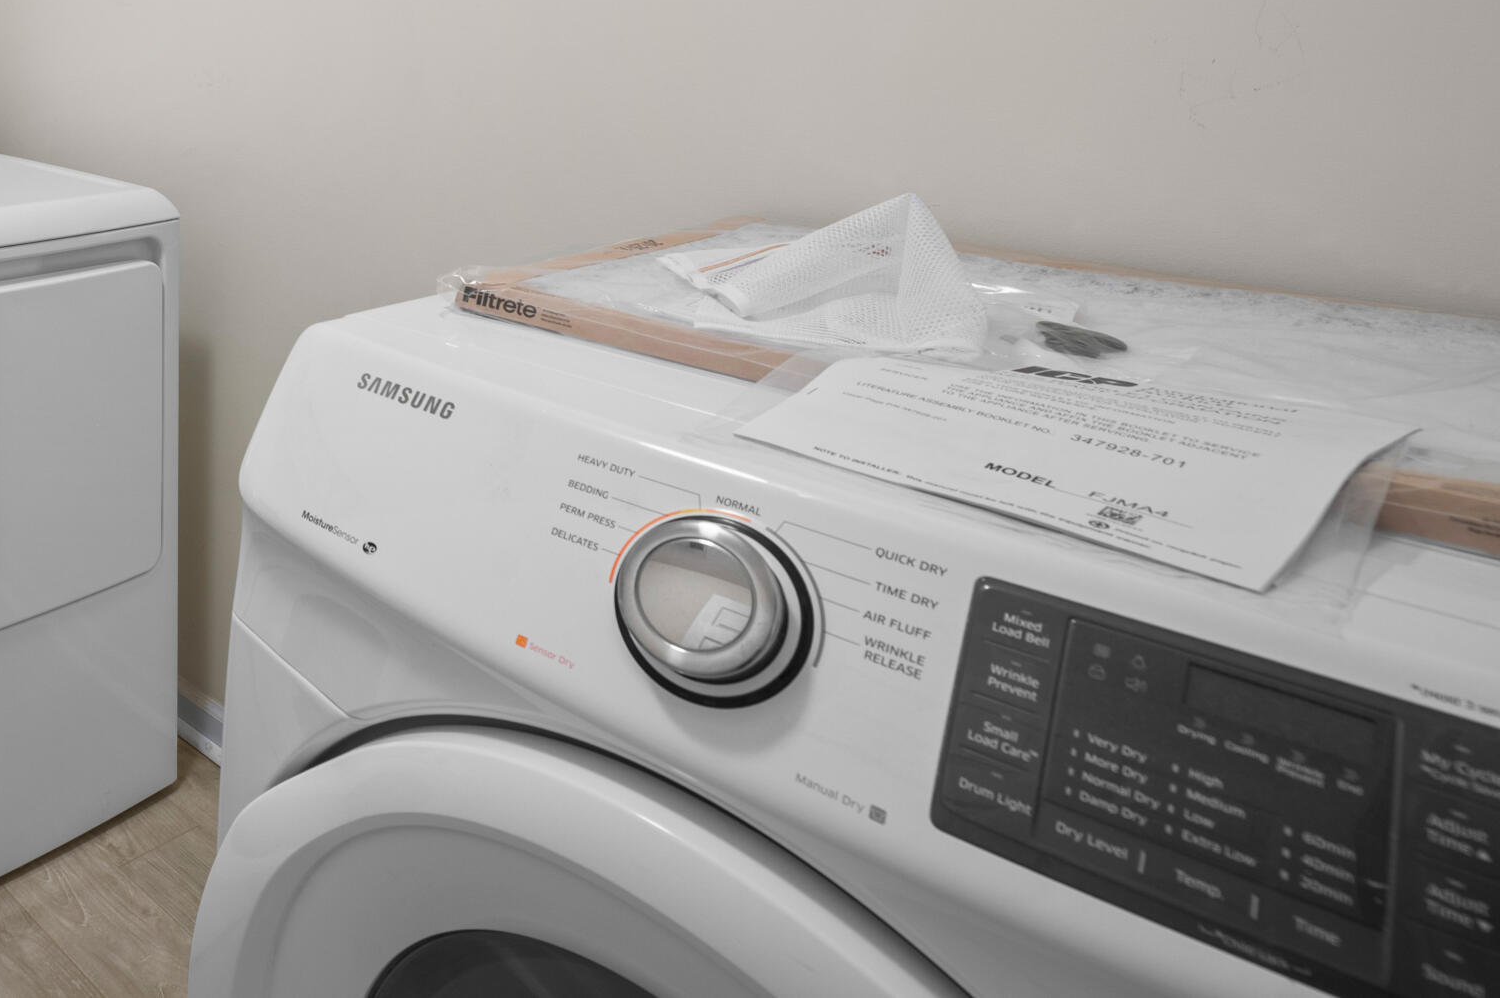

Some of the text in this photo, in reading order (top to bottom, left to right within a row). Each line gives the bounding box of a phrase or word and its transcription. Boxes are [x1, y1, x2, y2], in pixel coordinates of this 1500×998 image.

[462, 285, 537, 319] Filtrete
[1012, 365, 1138, 388] ICP
[357, 373, 455, 420] SAMSUNG
[918, 394, 973, 415] ASSEMBLY
[976, 409, 1028, 430] BOOKLET
[1070, 434, 1187, 469] 347928-701
[577, 453, 636, 478] HEAVY DUTY
[567, 479, 610, 500] BEDDING
[984, 461, 1056, 489] MODEL
[1088, 491, 1169, 518] FJMA4
[559, 502, 616, 529] PERM PRESS
[715, 495, 762, 517] NORMAL
[551, 526, 600, 552] DELICATES
[875, 547, 948, 577] QUICK DRY
[876, 581, 939, 610] TIME DRY
[863, 610, 932, 640] AIR FLUFF
[991, 622, 1050, 649] Load Bell
[1004, 612, 1043, 633] Mixed
[864, 635, 926, 667] WRINKLE
[864, 650, 923, 681] RELEASE
[987, 676, 1038, 702] Prevent
[990, 663, 1040, 690] Wrinkle
[967, 729, 999, 749] Load
[982, 721, 1019, 743] Small
[1087, 732, 1147, 764] Very Dry
[1084, 752, 1148, 785] More Dry
[796, 773, 866, 814] Manual Dry
[958, 776, 1034, 818] Drum Light
[1081, 770, 1161, 811] Normal Dry
[1121, 806, 1147, 827] Dry
[1055, 819, 1129, 861] Dry Level
[1293, 915, 1342, 947] Time
